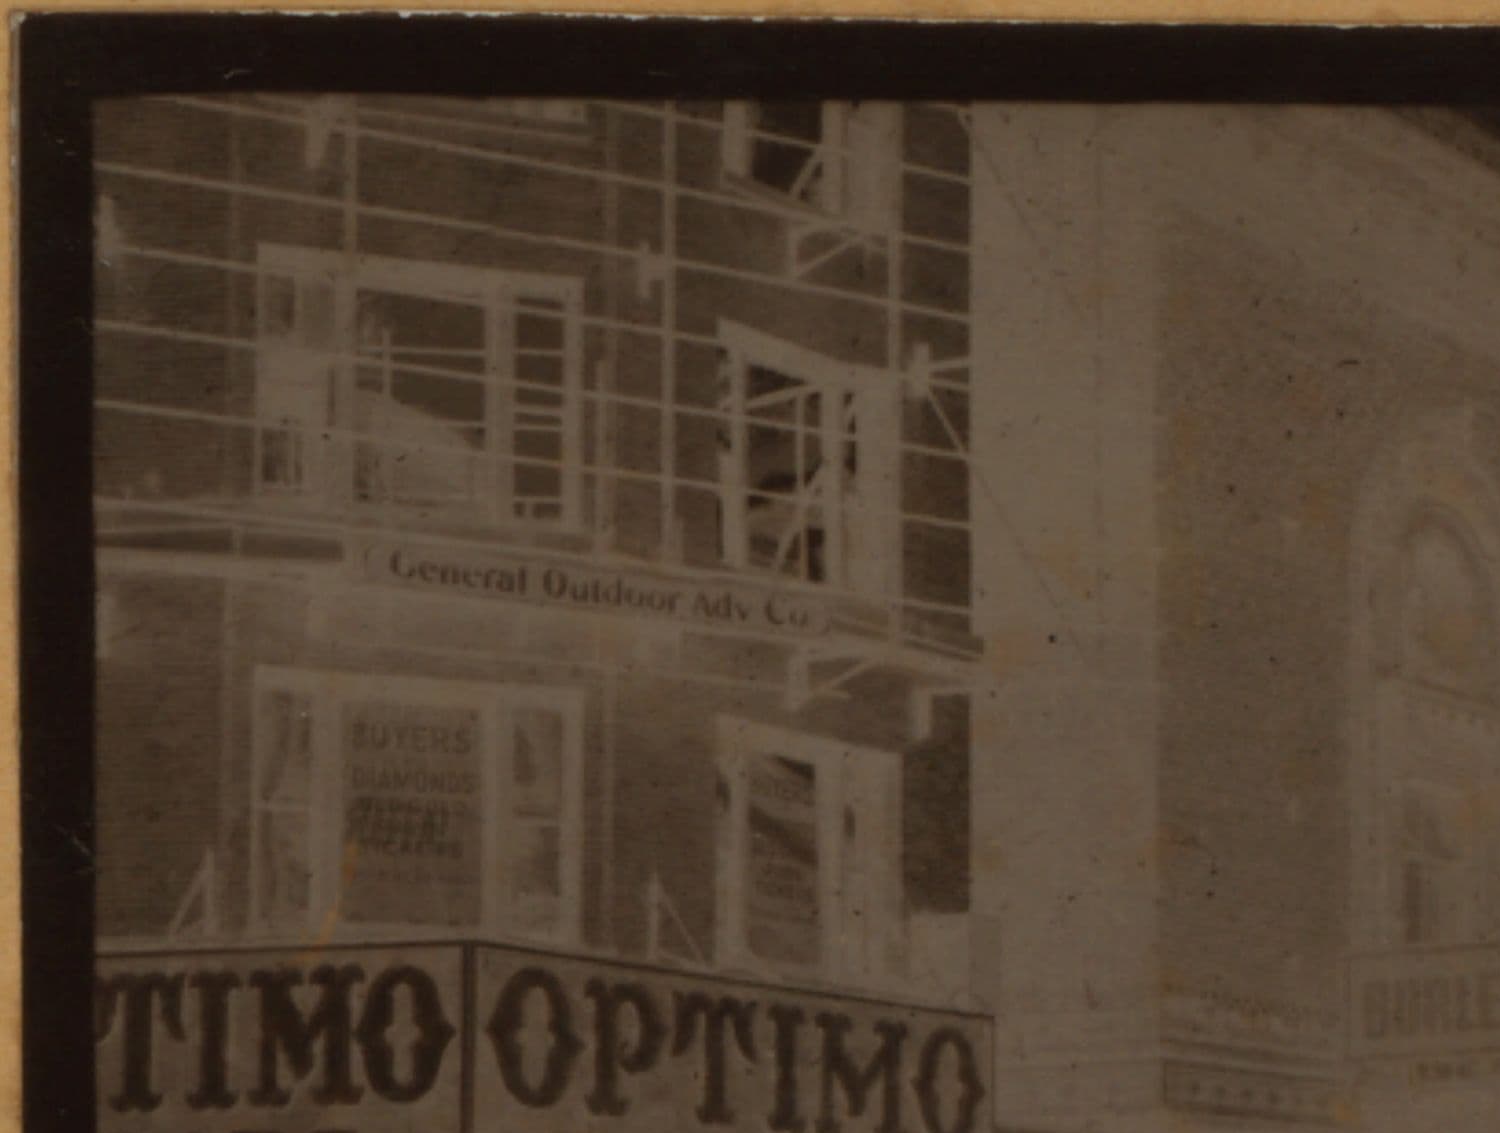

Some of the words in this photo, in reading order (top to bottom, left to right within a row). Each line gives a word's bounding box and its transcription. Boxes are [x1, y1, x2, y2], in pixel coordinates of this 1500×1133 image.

[388, 549, 528, 597] General
[541, 568, 683, 614] Outdoor
[691, 590, 750, 623] Adv
[351, 721, 473, 756] BUYERS
[351, 763, 476, 795] DIAMONDS
